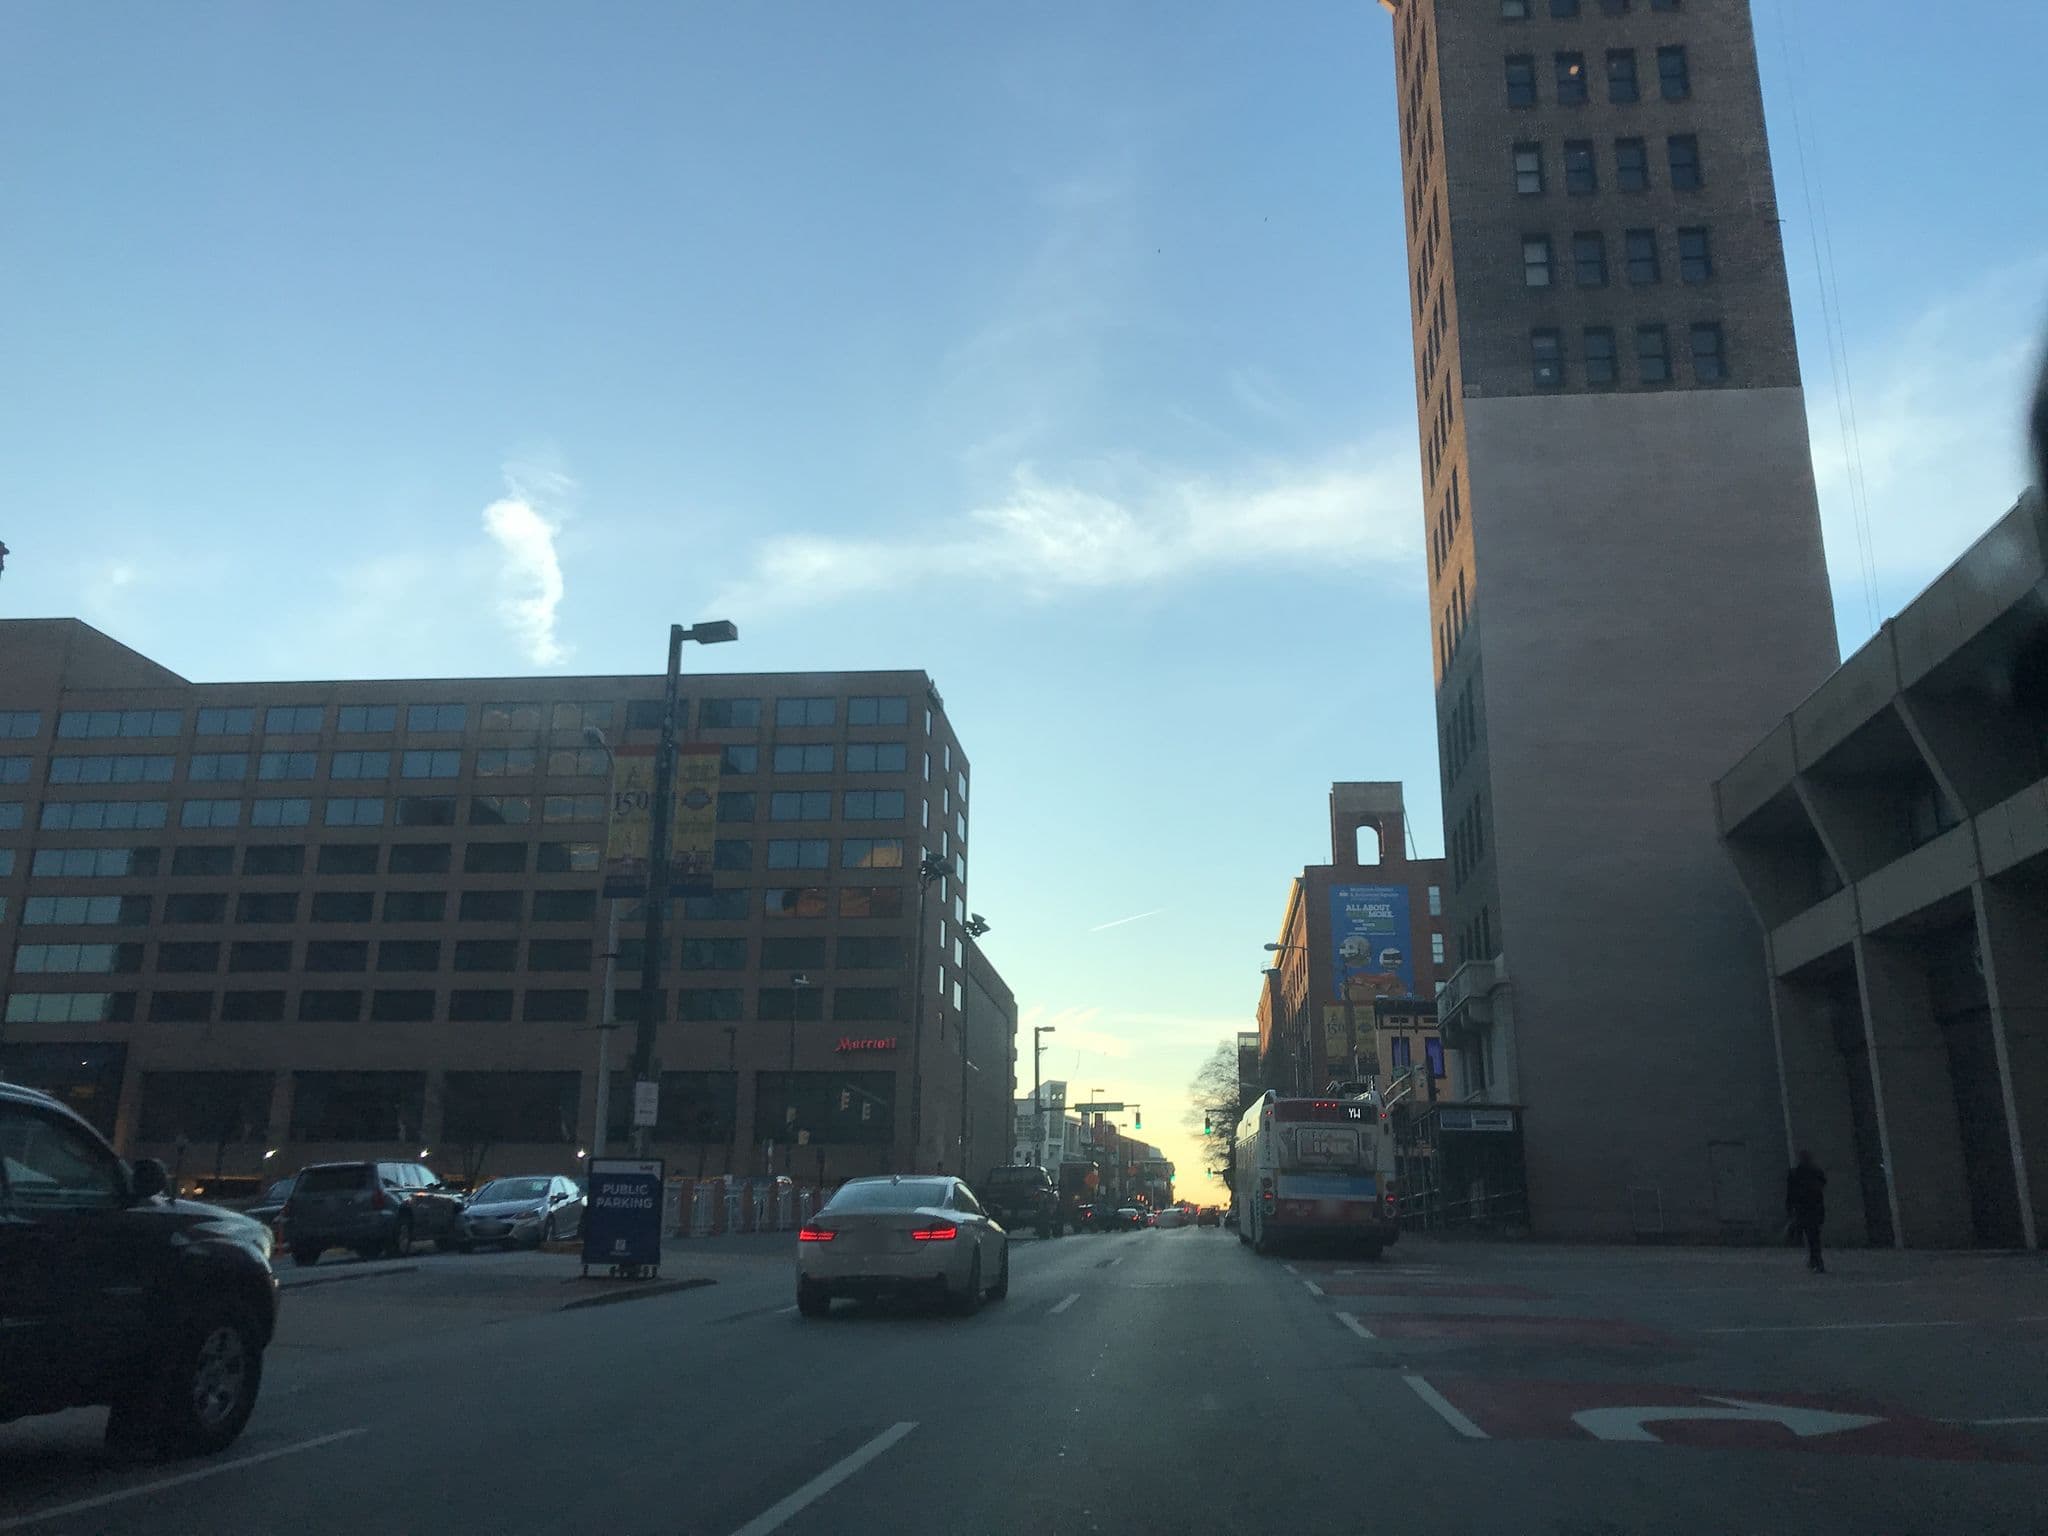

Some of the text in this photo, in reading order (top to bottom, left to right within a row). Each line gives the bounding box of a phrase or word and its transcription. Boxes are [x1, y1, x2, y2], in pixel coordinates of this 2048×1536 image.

[833, 1036, 897, 1053] Marriott
[1349, 1108, 1361, 1119] YW
[602, 1184, 648, 1195] PUBLIC
[595, 1198, 653, 1208] PARKING
